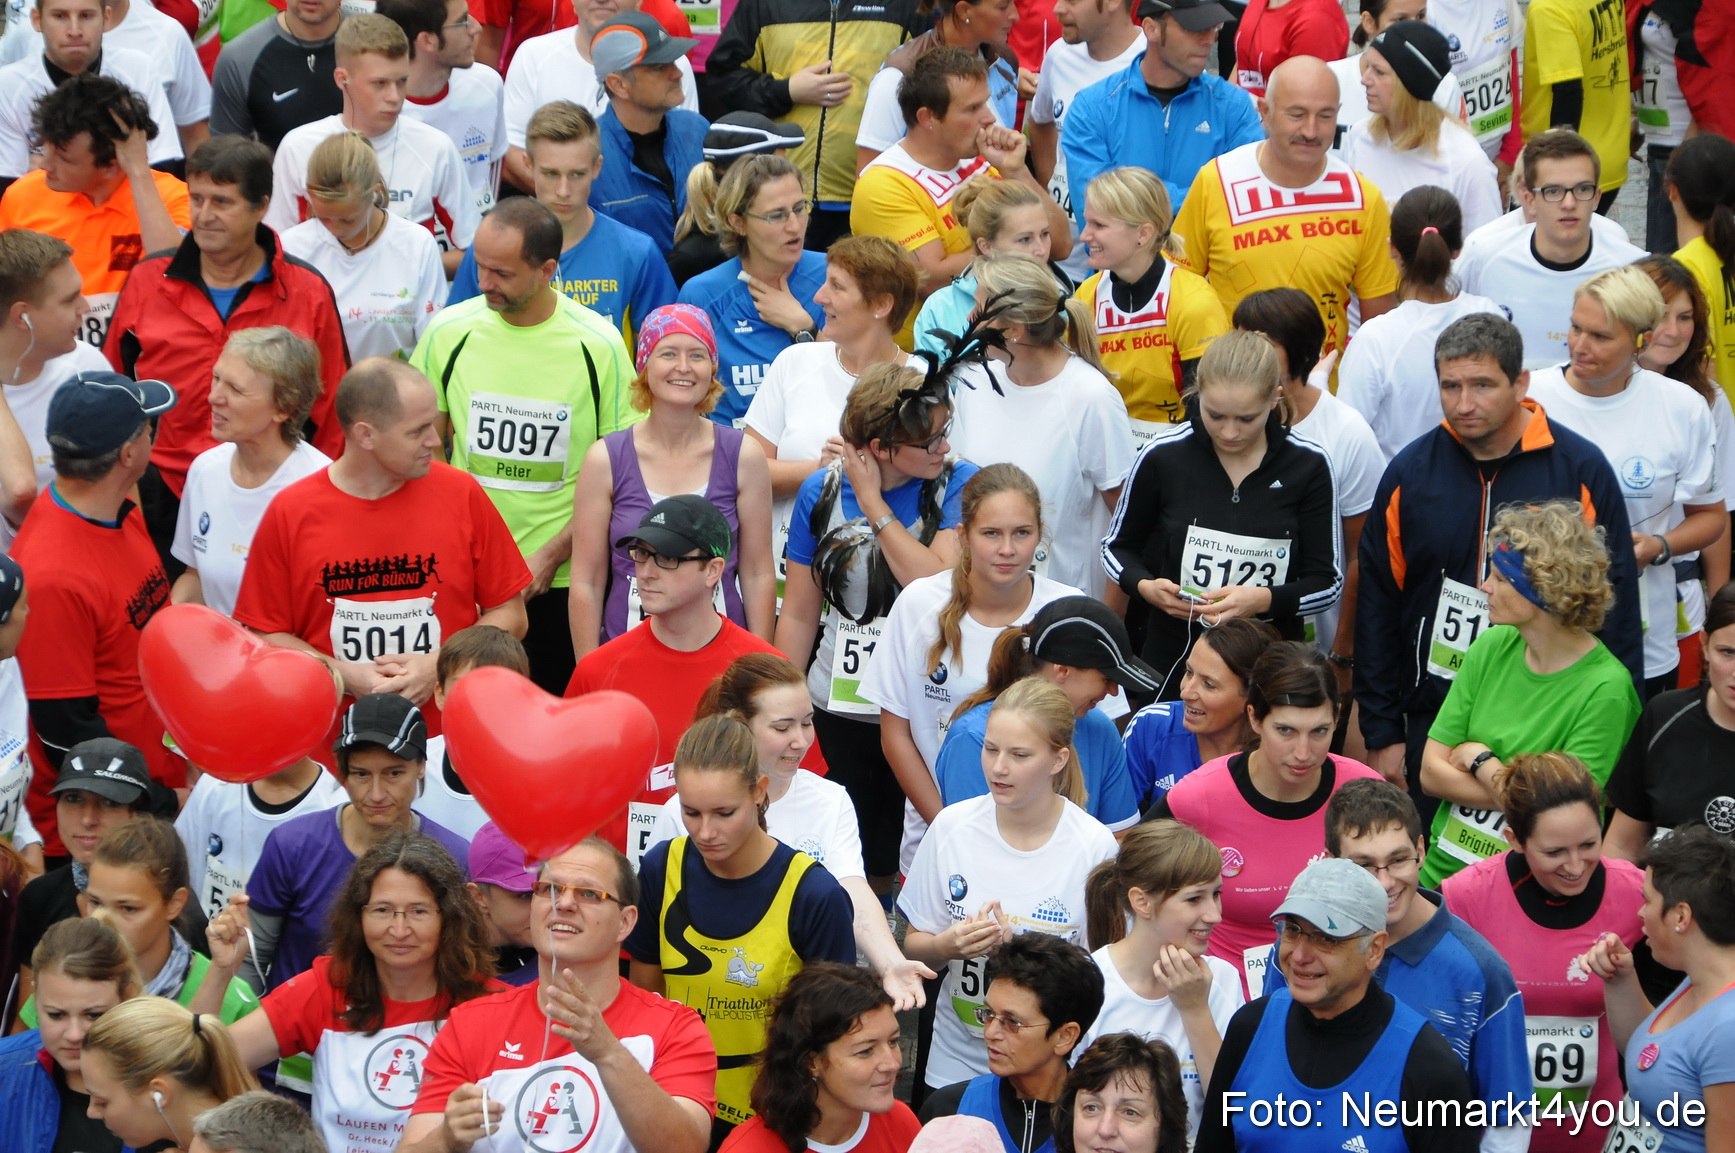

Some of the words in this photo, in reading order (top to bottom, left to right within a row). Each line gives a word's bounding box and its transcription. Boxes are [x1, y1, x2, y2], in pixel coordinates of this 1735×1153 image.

[1463, 70, 1513, 117] 5024
[1233, 224, 1292, 250] MAX
[1301, 217, 1363, 239] BÖGL
[1132, 333, 1172, 350] BÖGL
[471, 400, 503, 413] PARTL
[505, 406, 552, 420] Neumarkt
[477, 416, 560, 457] 5097
[496, 461, 532, 478] Peter
[1188, 536, 1223, 551] PARTL
[1226, 544, 1273, 558] Neumarkt
[1192, 553, 1277, 588] 5123
[328, 577, 354, 592] RUN
[357, 573, 380, 590] FOR
[381, 570, 421, 587] BÜRNI
[1442, 587, 1472, 606] PARTL
[335, 608, 368, 621] PARTL
[371, 608, 423, 621] Neumarkt
[839, 622, 866, 635] PARTL
[342, 622, 432, 662] 5014
[924, 684, 951, 698] PARTL
[925, 693, 952, 703] Neumarkt
[961, 957, 989, 997] 5
[1525, 1027, 1575, 1037] eumarkt
[499, 1049, 524, 1061] erima
[1534, 1042, 1585, 1084] 69
[337, 1113, 387, 1131] LAUFEN
[348, 1133, 362, 1143] Dr.
[364, 1135, 388, 1146] Heck
